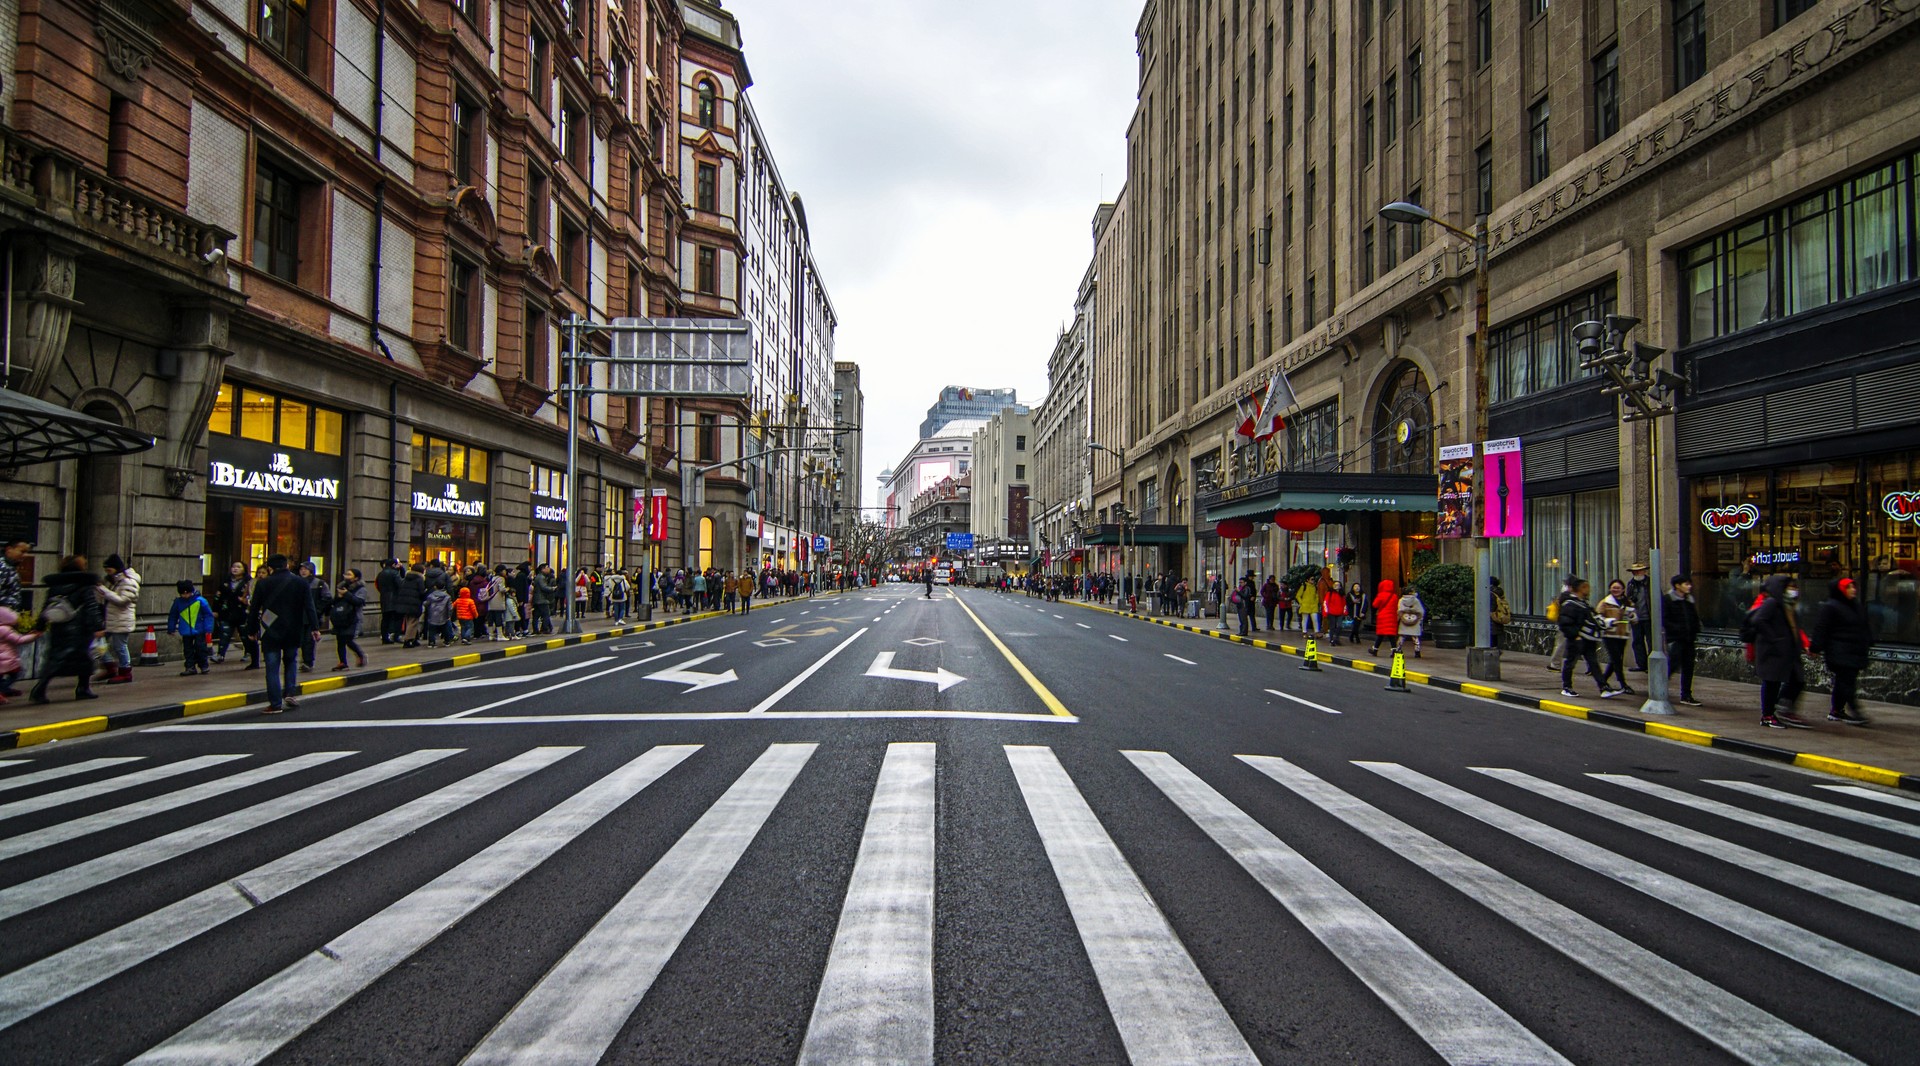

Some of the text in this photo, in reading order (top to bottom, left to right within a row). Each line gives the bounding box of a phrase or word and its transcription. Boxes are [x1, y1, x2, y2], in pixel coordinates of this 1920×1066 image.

[1487, 440, 1509, 448] swatch
[211, 461, 339, 500] BLANCPAIN
[412, 492, 485, 517] BLANCPAIN
[536, 506, 565, 522] swatch
